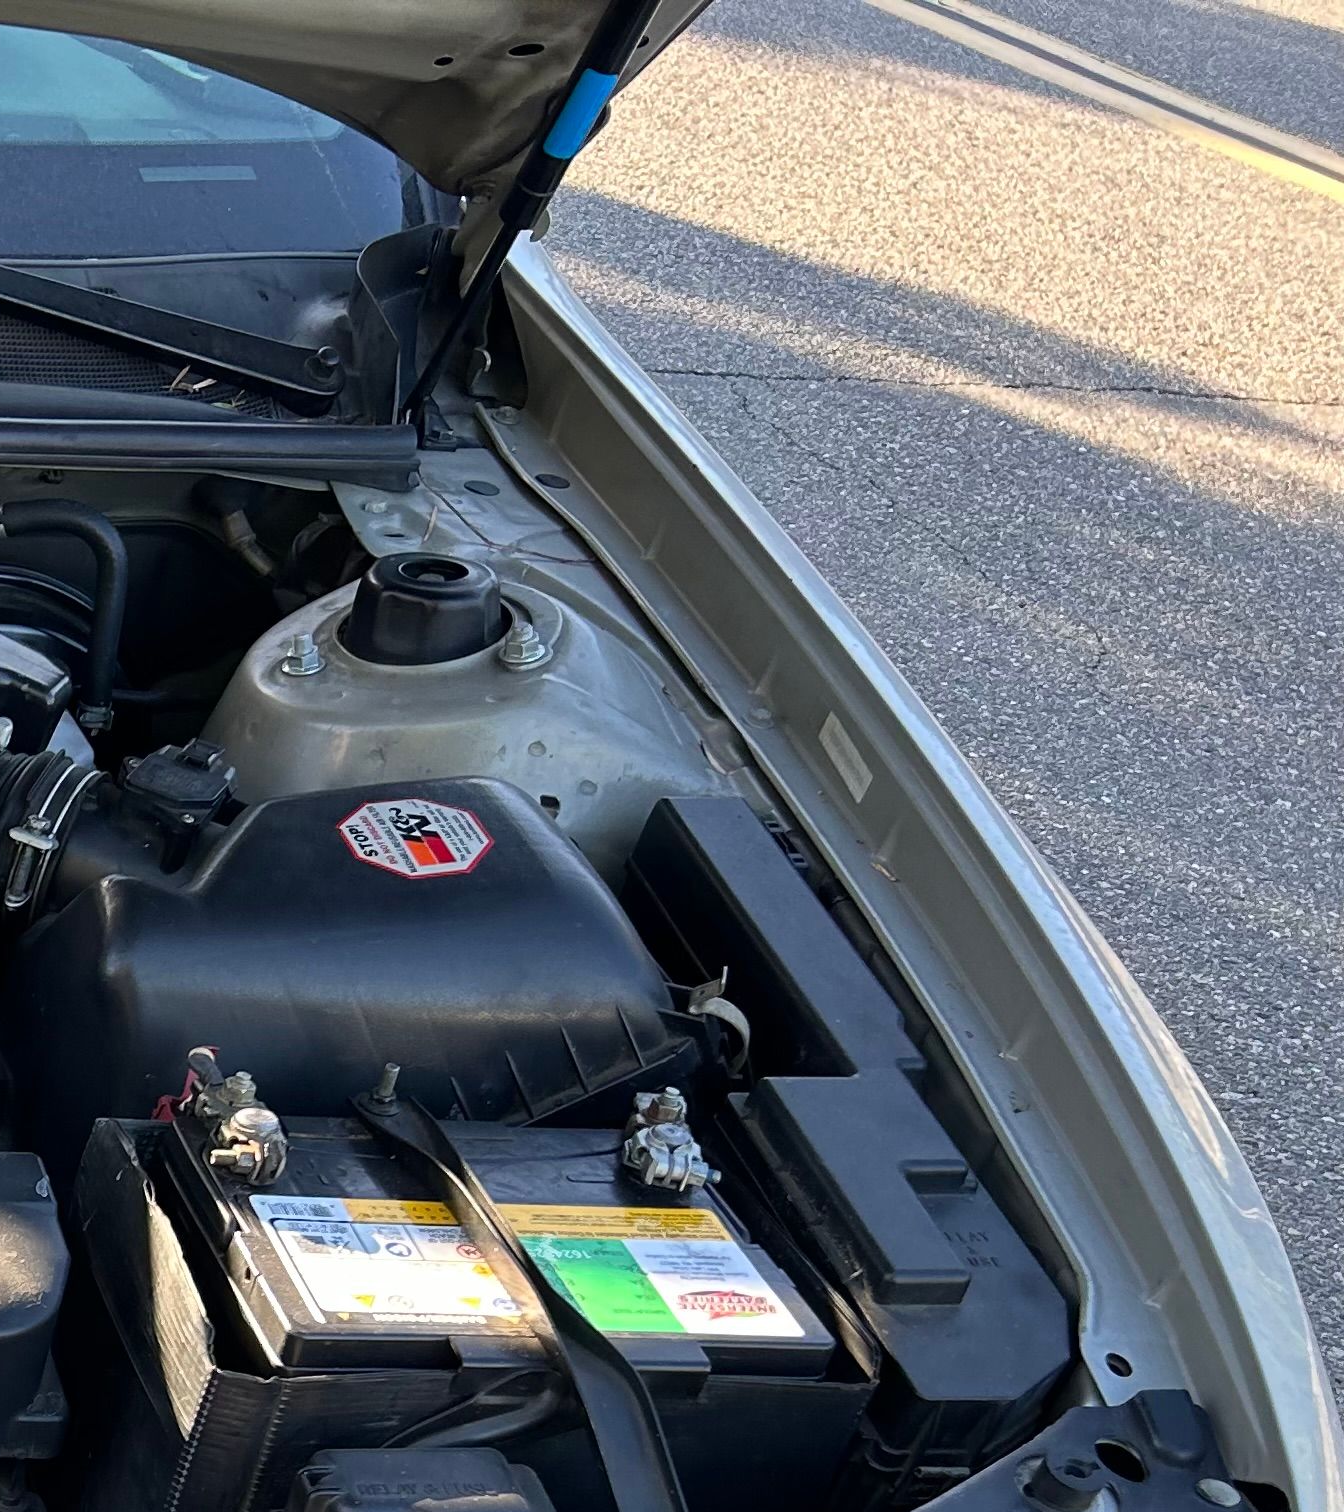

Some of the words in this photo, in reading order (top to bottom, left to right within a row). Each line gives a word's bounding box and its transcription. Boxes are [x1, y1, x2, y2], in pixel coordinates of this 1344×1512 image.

[357, 814, 382, 840] DISCARD
[345, 823, 380, 857] STOP!
[375, 841, 392, 854] NOT
[384, 854, 399, 864] DO
[678, 1294, 767, 1305] BATTERIES
[677, 1302, 777, 1314] INTERSTATE
